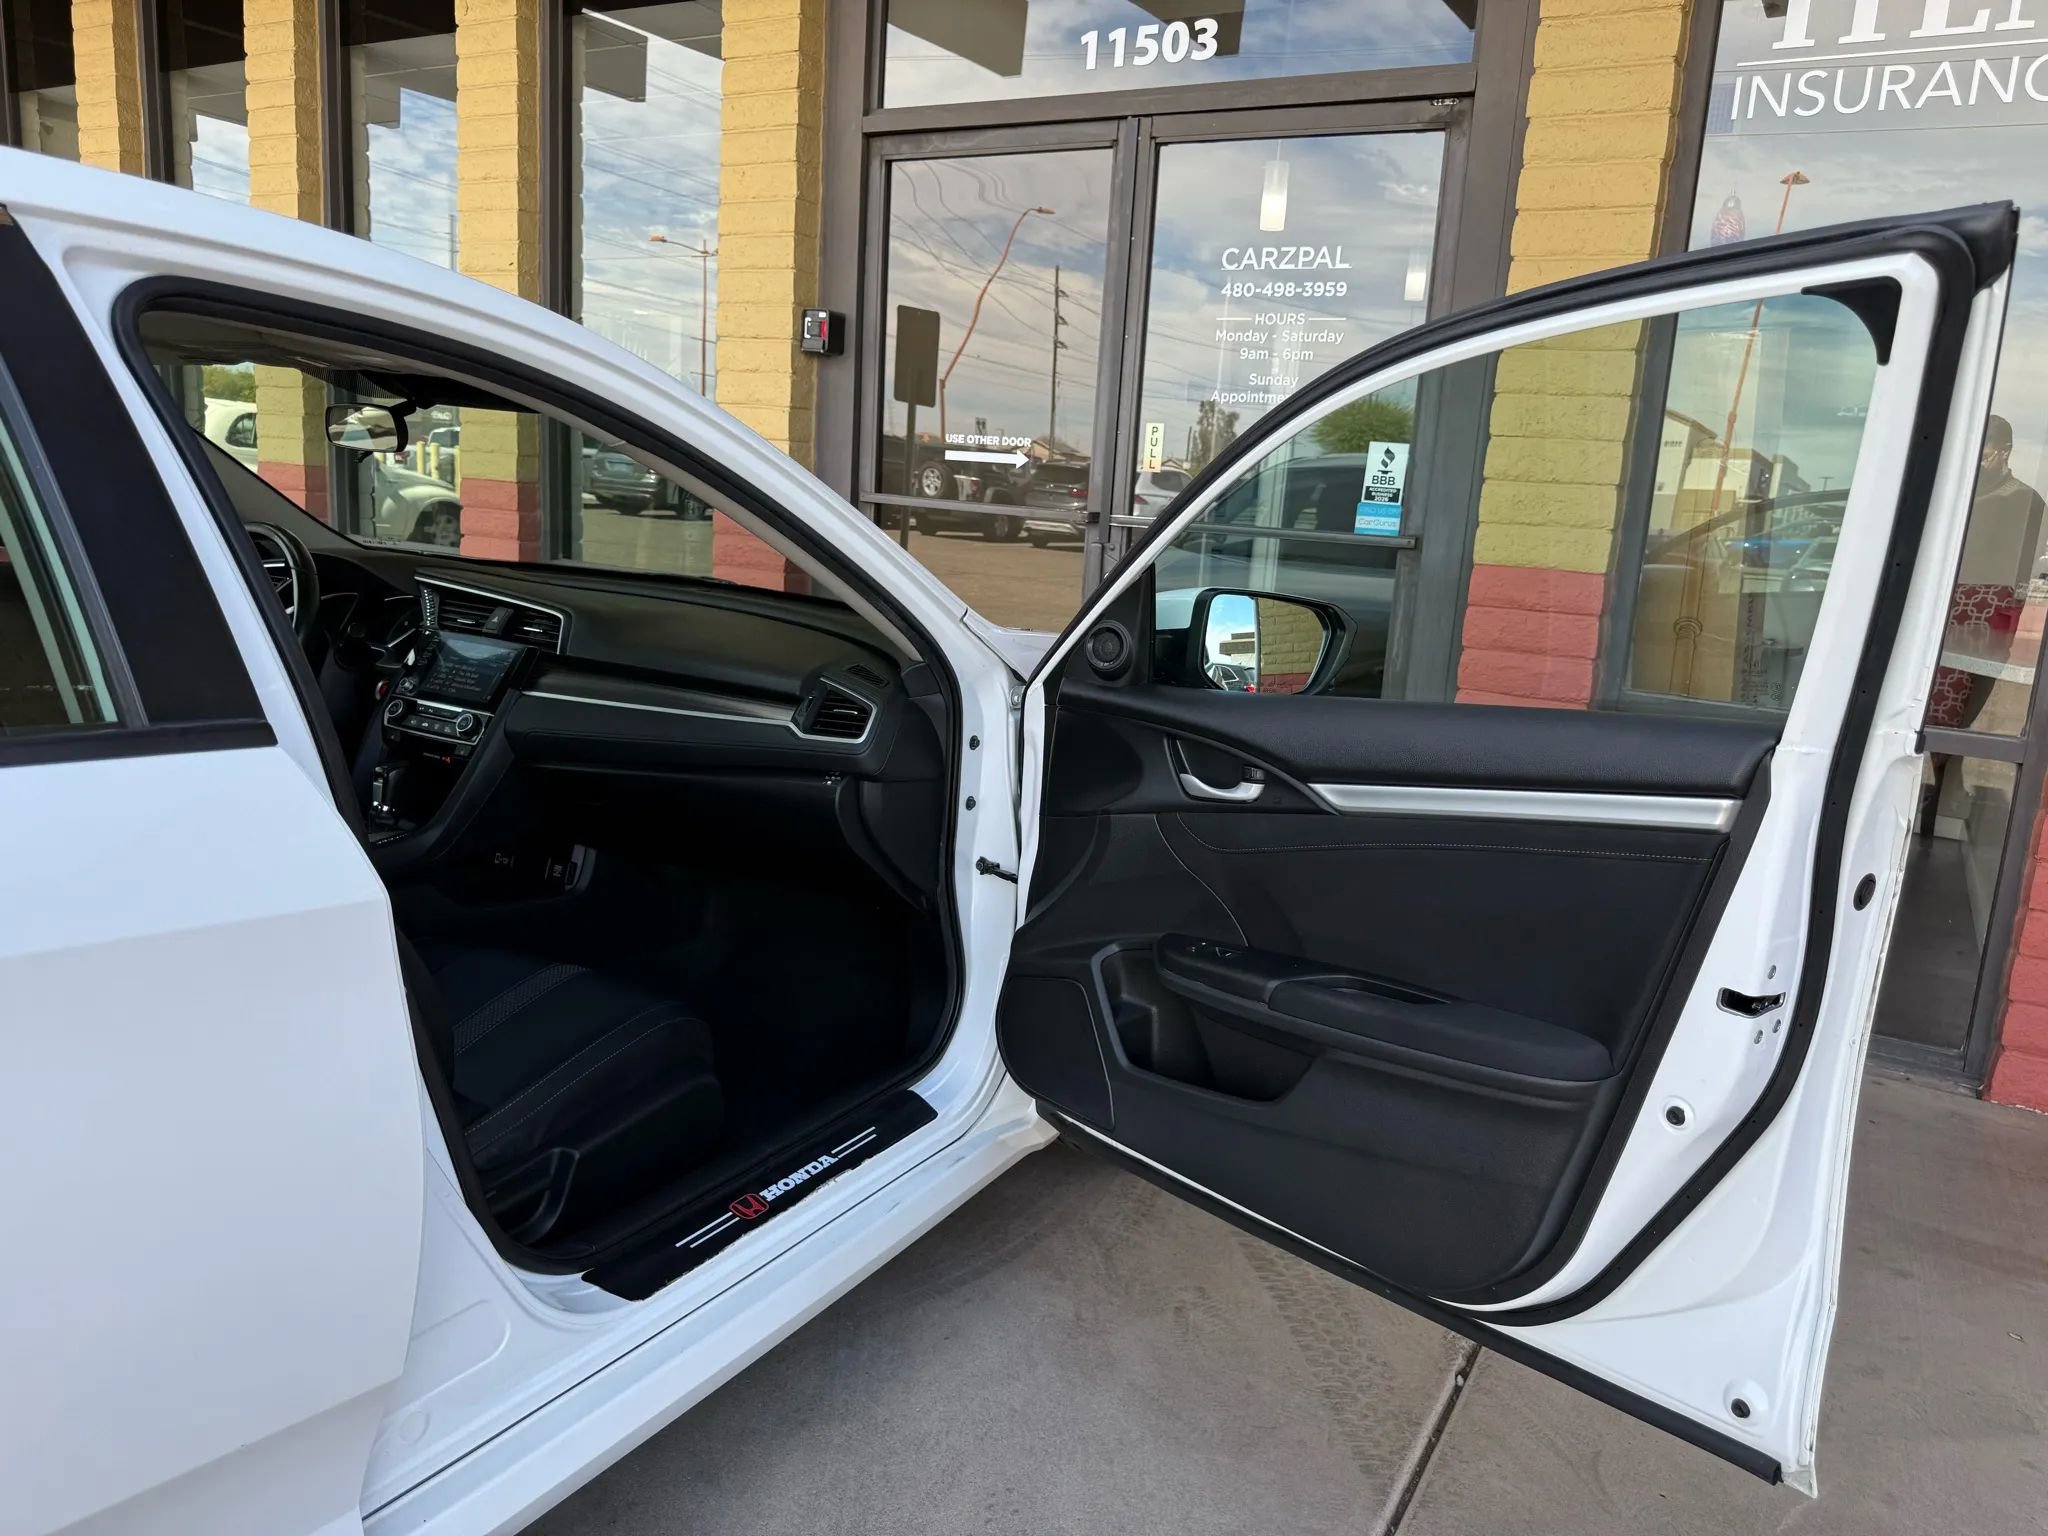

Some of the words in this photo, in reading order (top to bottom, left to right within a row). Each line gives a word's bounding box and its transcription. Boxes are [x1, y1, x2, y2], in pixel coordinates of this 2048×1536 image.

[1080, 18, 1219, 70] 11503
[1221, 245, 1352, 270] CARZPAL
[1221, 281, 1348, 297] 480-498-3959
[1254, 313, 1306, 325] HOURS
[1215, 329, 1269, 344] Monday
[1282, 329, 1345, 344] Saturday
[1239, 347, 1269, 360] 9am
[1282, 347, 1314, 361] 6pm
[1249, 373, 1299, 387] Sunday
[945, 433, 965, 444] USE
[966, 434, 1000, 446] OTHER
[1001, 436, 1032, 447] DOOR
[1148, 426, 1159, 470] PULL
[1371, 475, 1396, 486] BBB
[758, 1155, 839, 1202] HONDA
